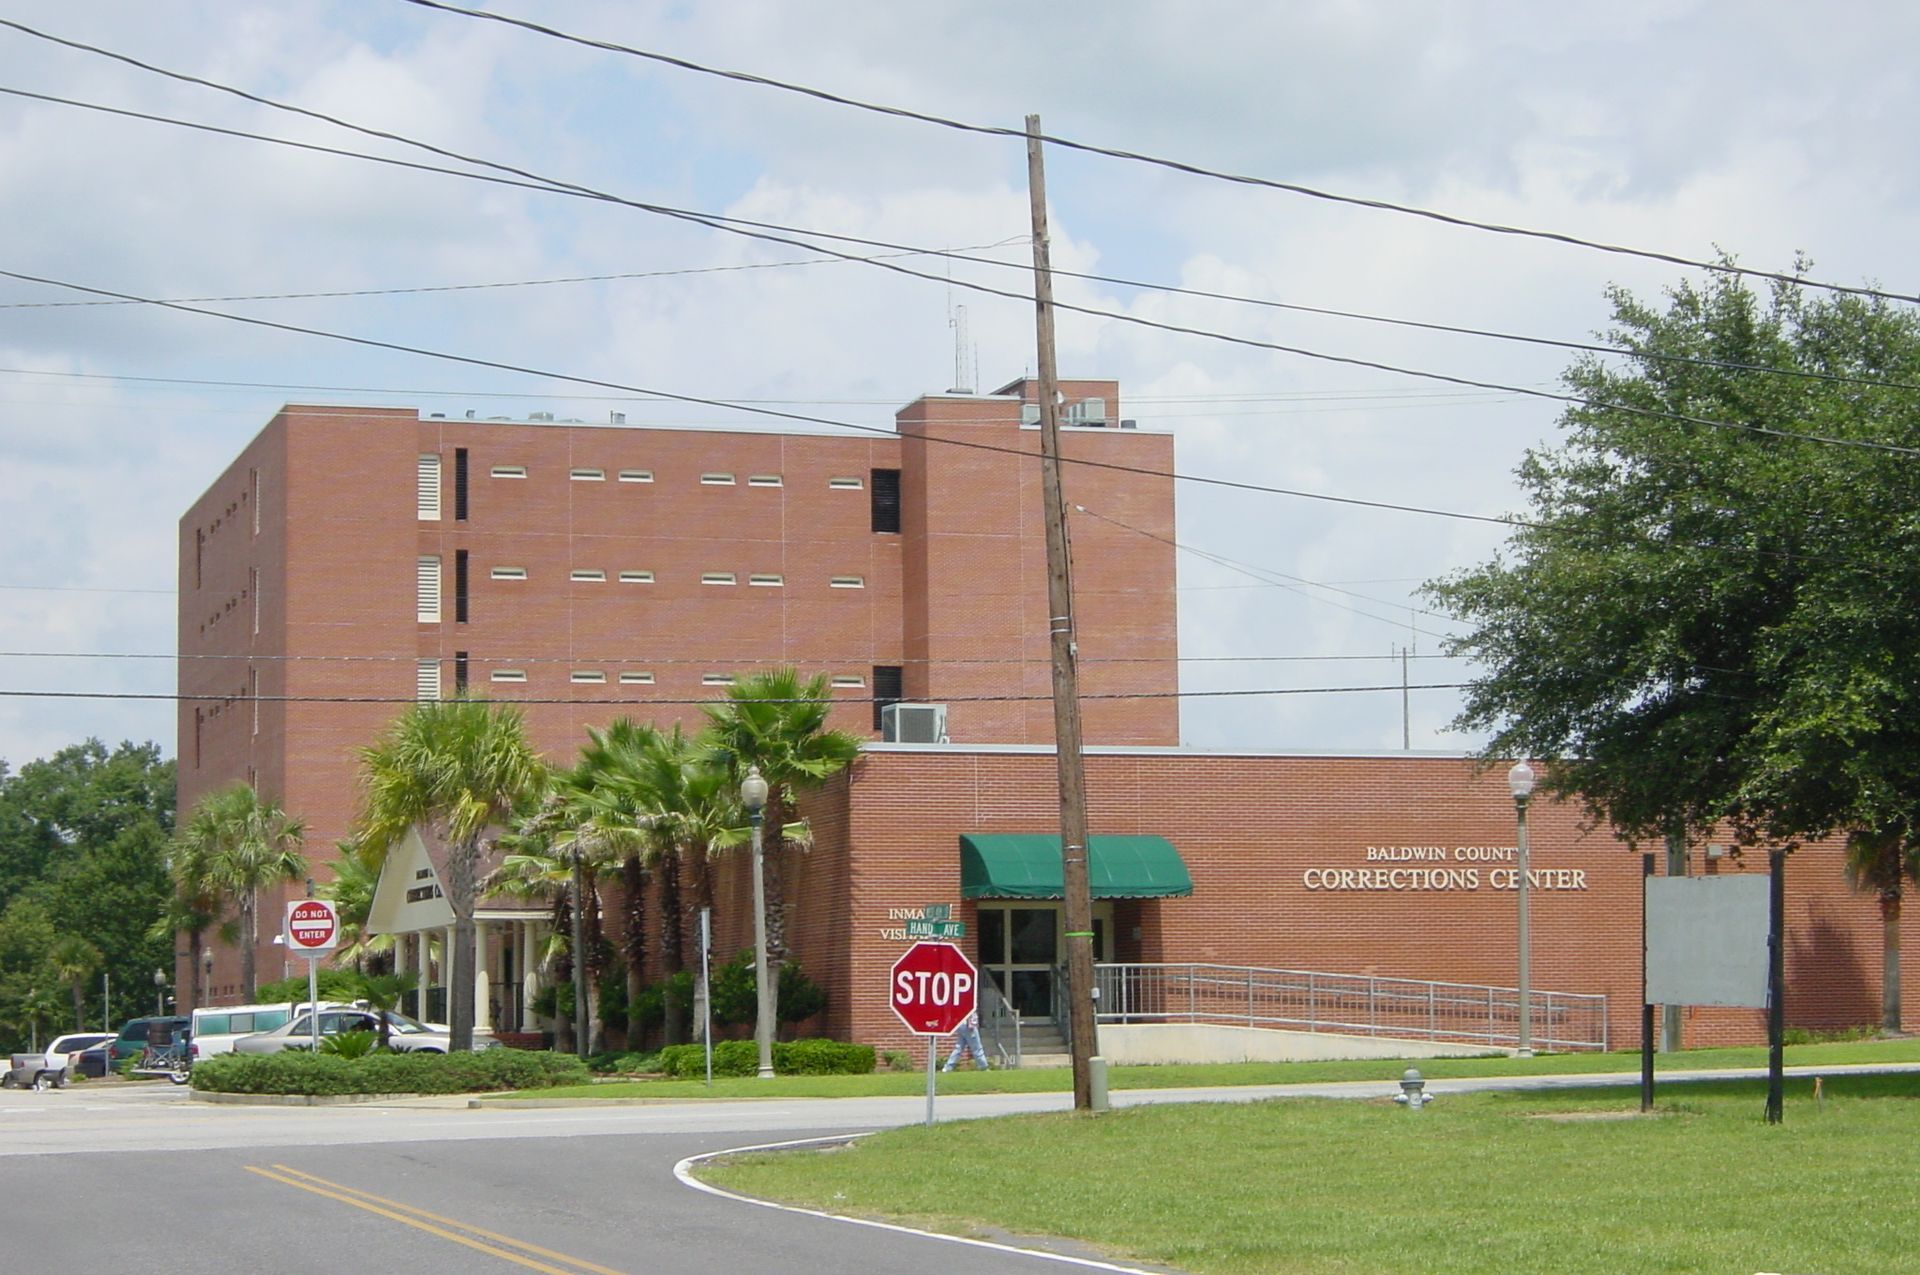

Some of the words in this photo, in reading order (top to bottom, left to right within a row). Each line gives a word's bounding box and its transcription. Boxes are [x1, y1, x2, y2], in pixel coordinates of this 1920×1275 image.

[1367, 847, 1446, 861] BALDWIN
[1303, 868, 1479, 890] CORRECTIONS
[1489, 868, 1588, 889] CENTER
[295, 911, 307, 919] DO
[310, 909, 328, 918] NOT
[888, 908, 926, 920] INMA
[299, 930, 326, 940] ENTER
[910, 922, 934, 935] HAND
[943, 924, 960, 936] AVE
[896, 970, 972, 1006] STOP
